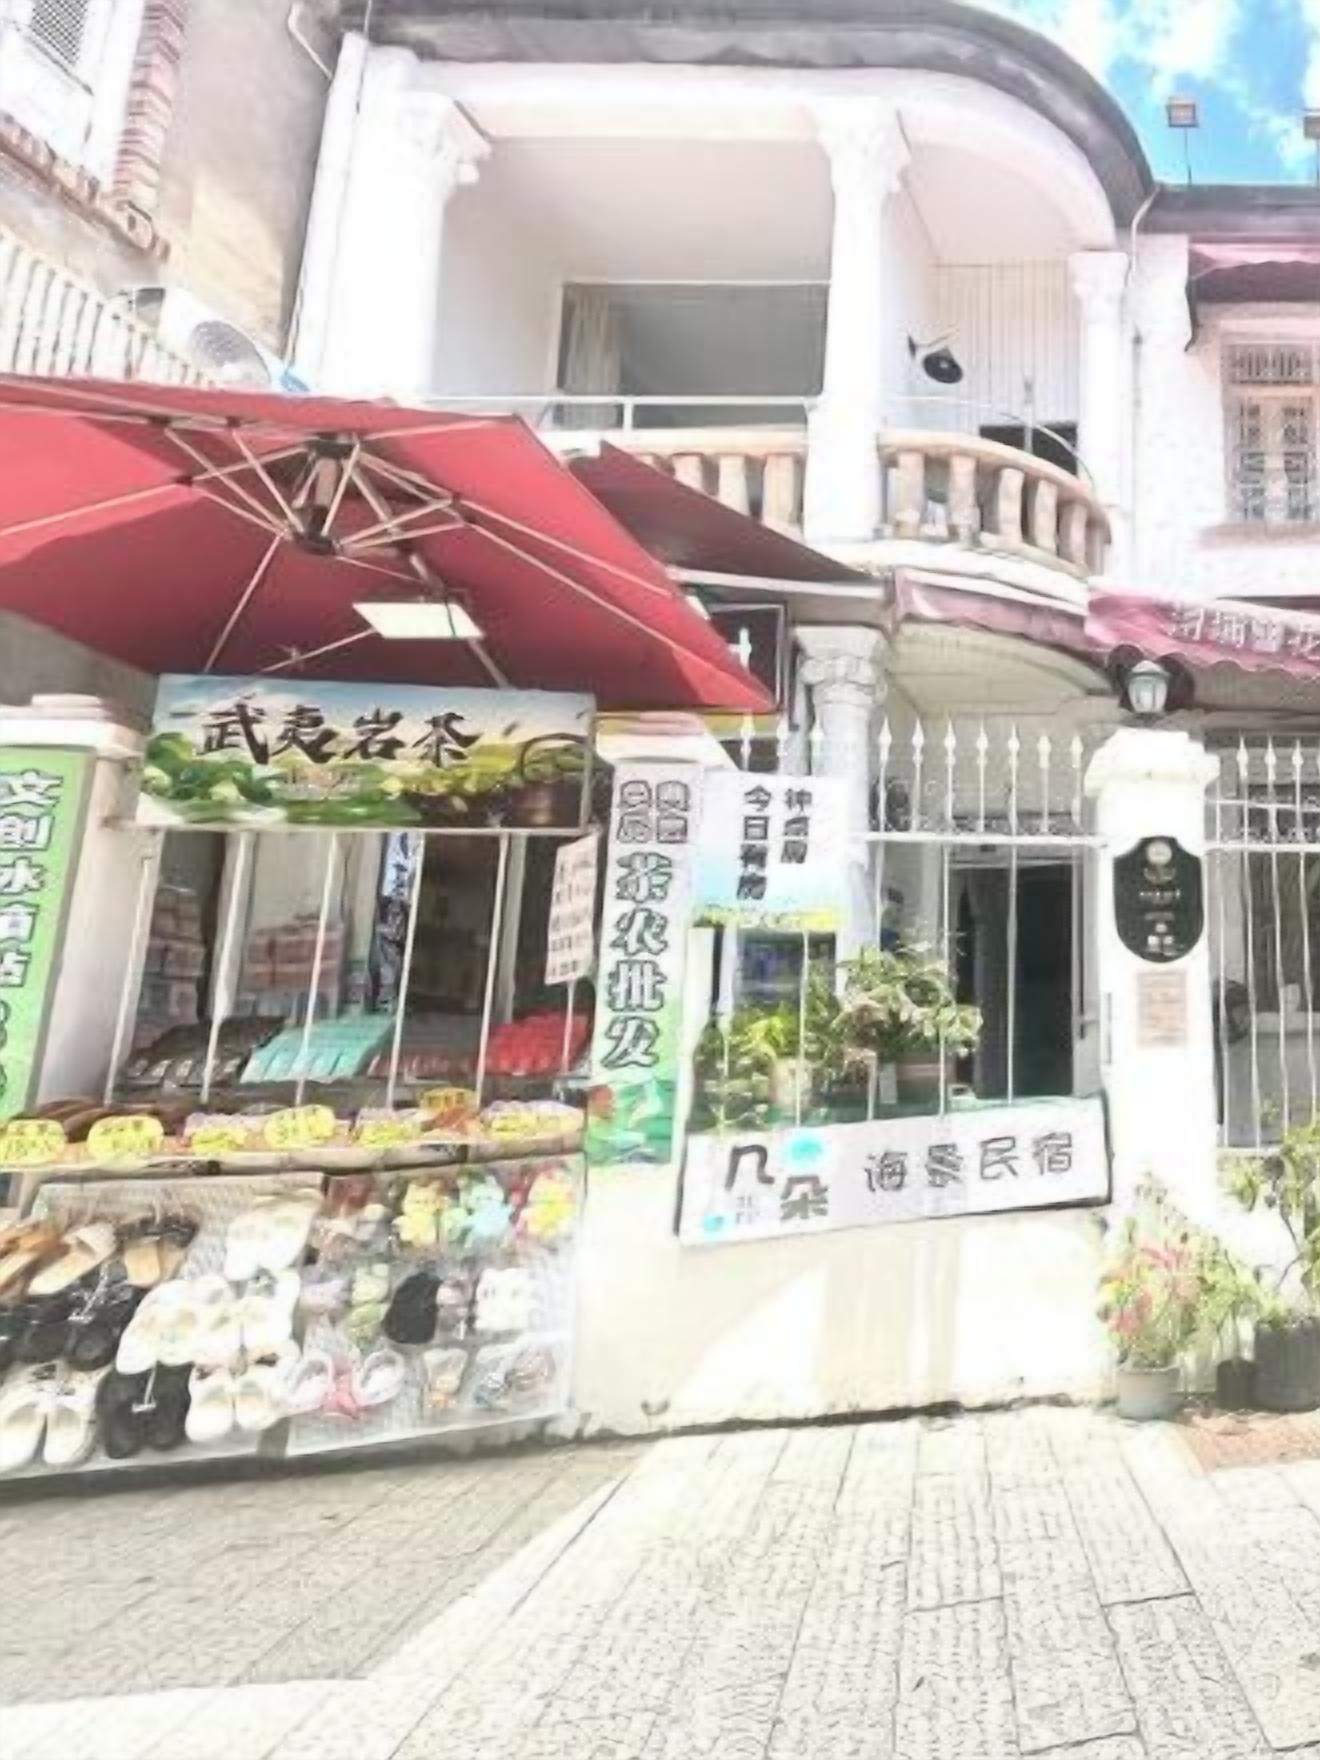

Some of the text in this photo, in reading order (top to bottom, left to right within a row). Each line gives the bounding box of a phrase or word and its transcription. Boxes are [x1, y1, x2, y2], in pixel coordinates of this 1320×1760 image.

[202, 693, 482, 767] 武夷岩茶
[602, 851, 672, 1069] 茶农批发
[864, 1132, 1074, 1193] 海景民宿
